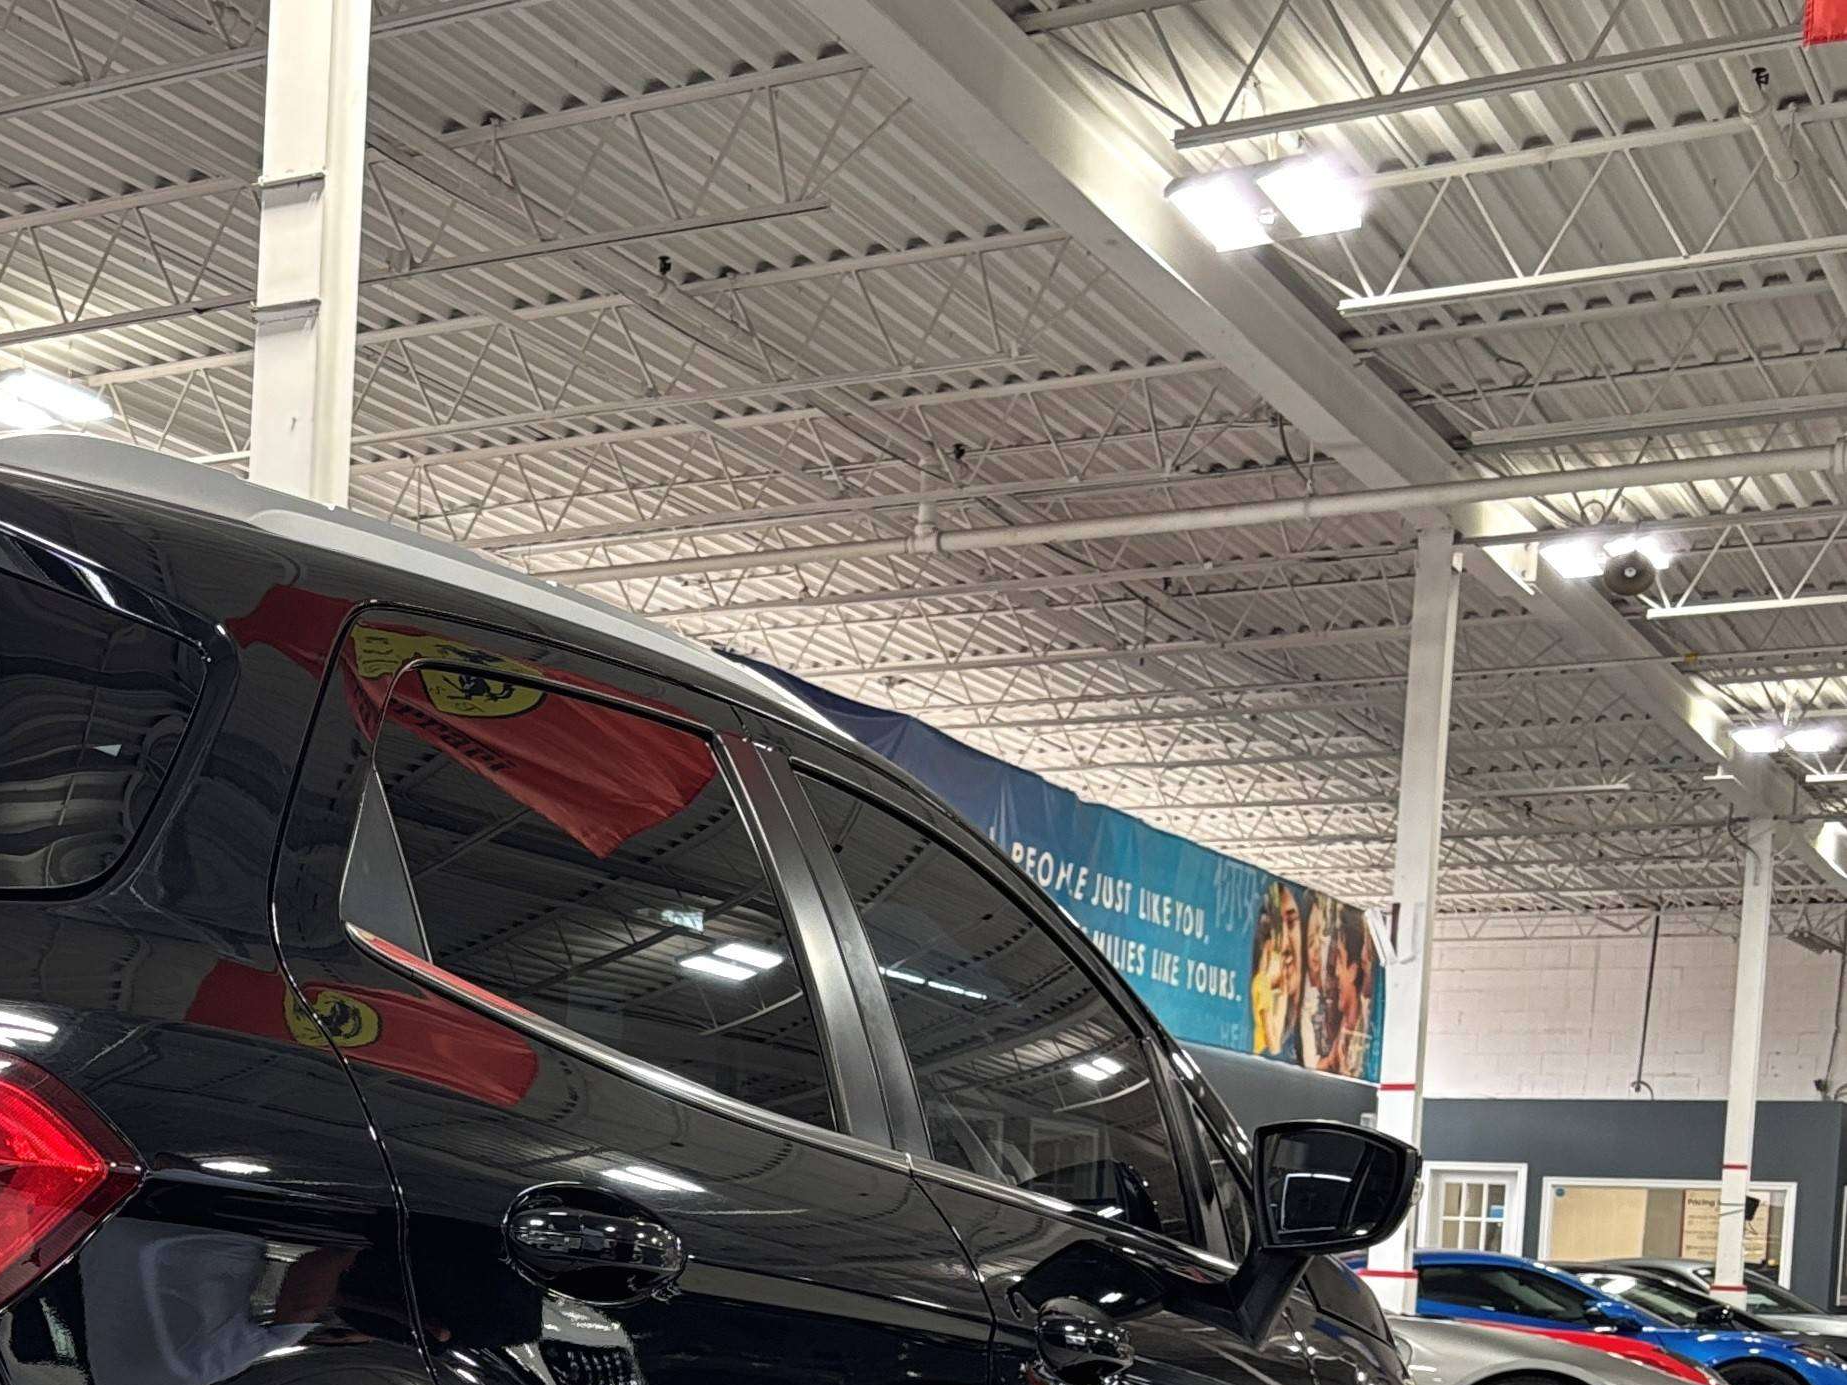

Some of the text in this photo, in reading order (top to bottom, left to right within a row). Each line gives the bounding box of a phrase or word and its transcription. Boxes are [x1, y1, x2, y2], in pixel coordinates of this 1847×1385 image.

[1091, 873, 1132, 914] JUST
[1138, 888, 1172, 928] LIKE
[1174, 900, 1210, 944] YOU.
[1082, 926, 1242, 1002] MILIES LIKE YOURS.
